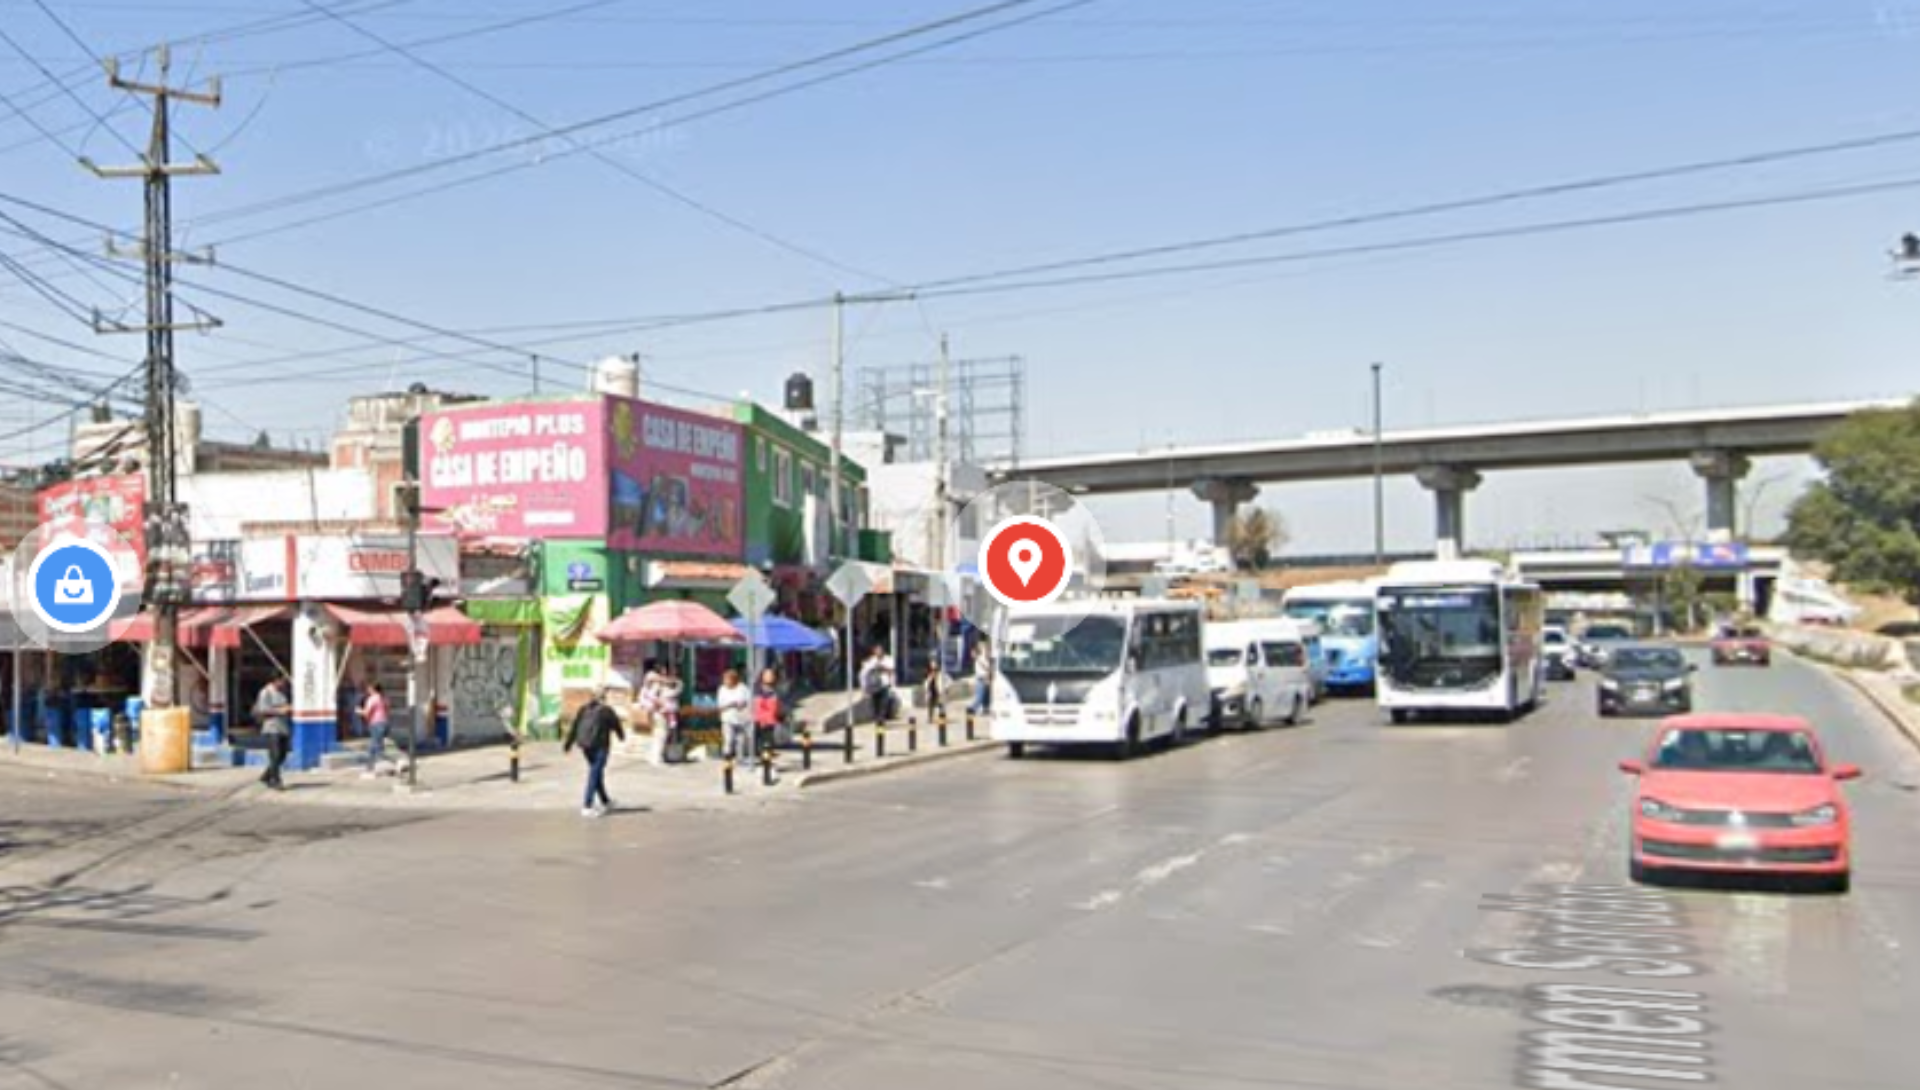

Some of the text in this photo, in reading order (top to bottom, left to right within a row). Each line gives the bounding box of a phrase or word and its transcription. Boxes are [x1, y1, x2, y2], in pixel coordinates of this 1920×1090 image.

[536, 413, 585, 436] PLUS
[430, 453, 472, 488] CASA
[477, 452, 498, 486] DE
